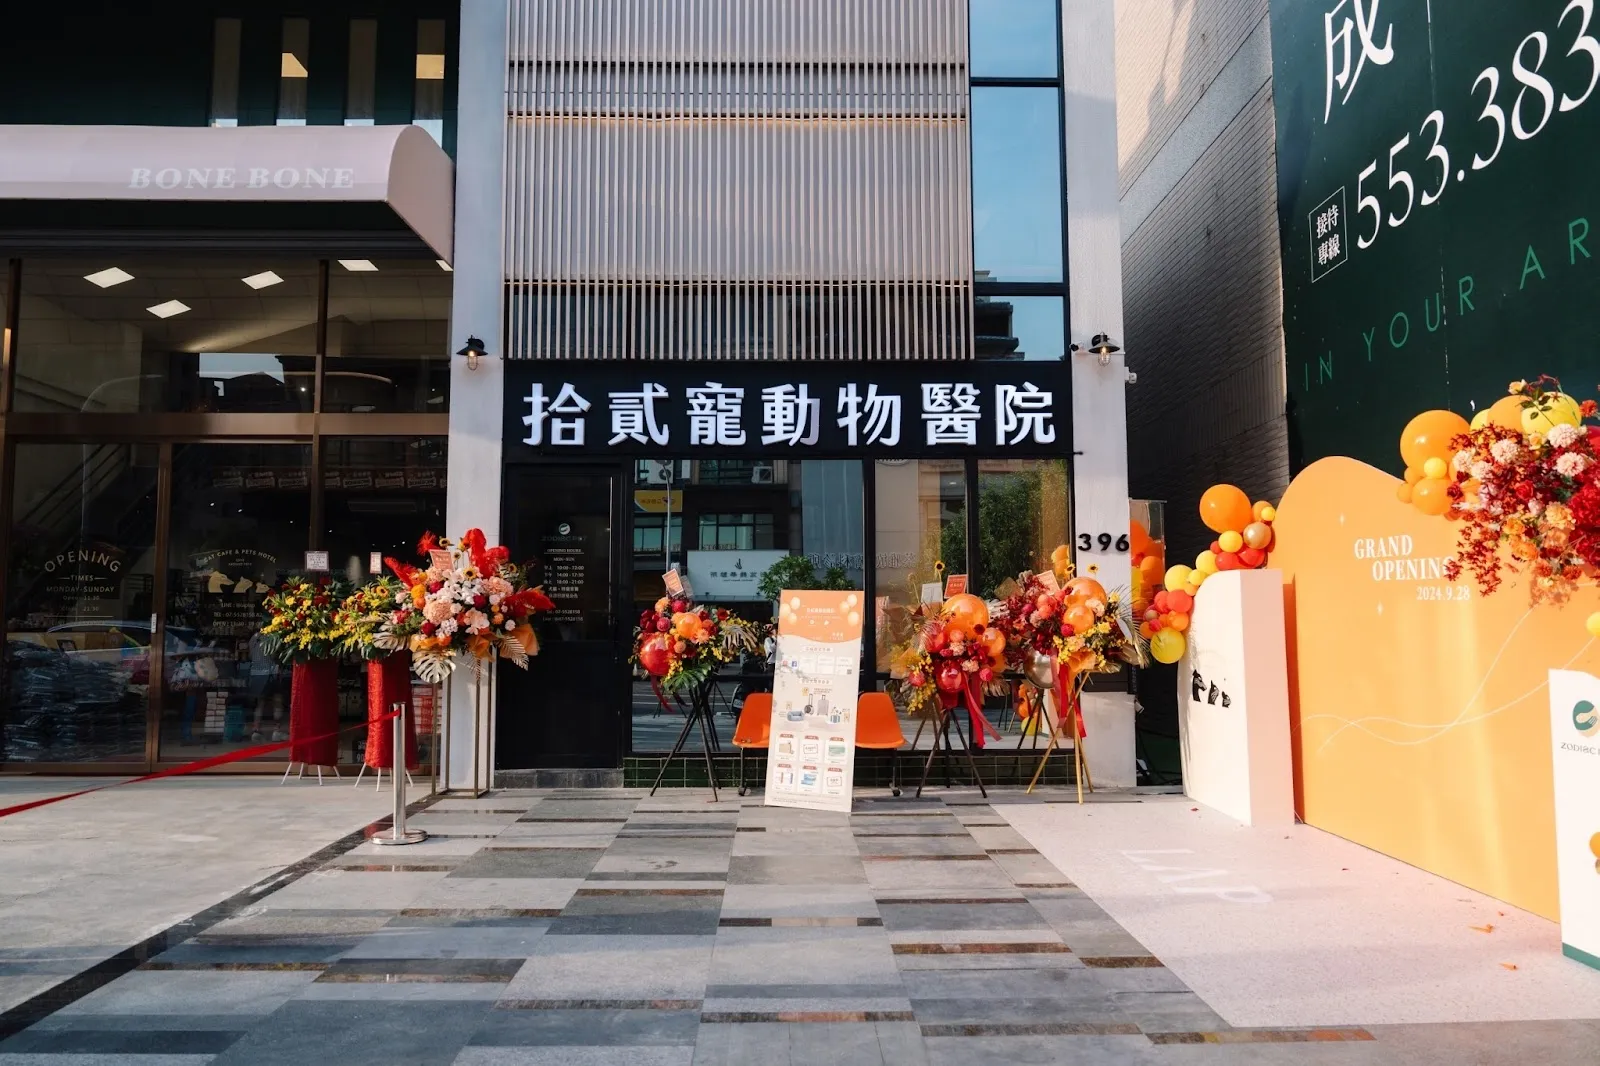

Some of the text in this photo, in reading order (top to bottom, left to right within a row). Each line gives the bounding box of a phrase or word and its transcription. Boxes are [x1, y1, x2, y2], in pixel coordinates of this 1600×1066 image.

[129, 167, 354, 189] BONE BONE
[1316, 204, 1339, 239] 接待
[1318, 233, 1340, 265] 專線
[1304, 351, 1333, 391] IN
[1363, 276, 1475, 361] YOUR
[522, 382, 1056, 447] 拾貳寵動物醫院
[1077, 533, 1130, 552] 396
[1354, 534, 1413, 560] GRAND
[44, 549, 121, 573] OPENING
[258, 551, 277, 564] HOTEL
[70, 574, 94, 582] TIMES
[1416, 585, 1471, 601] 2024.9.28
